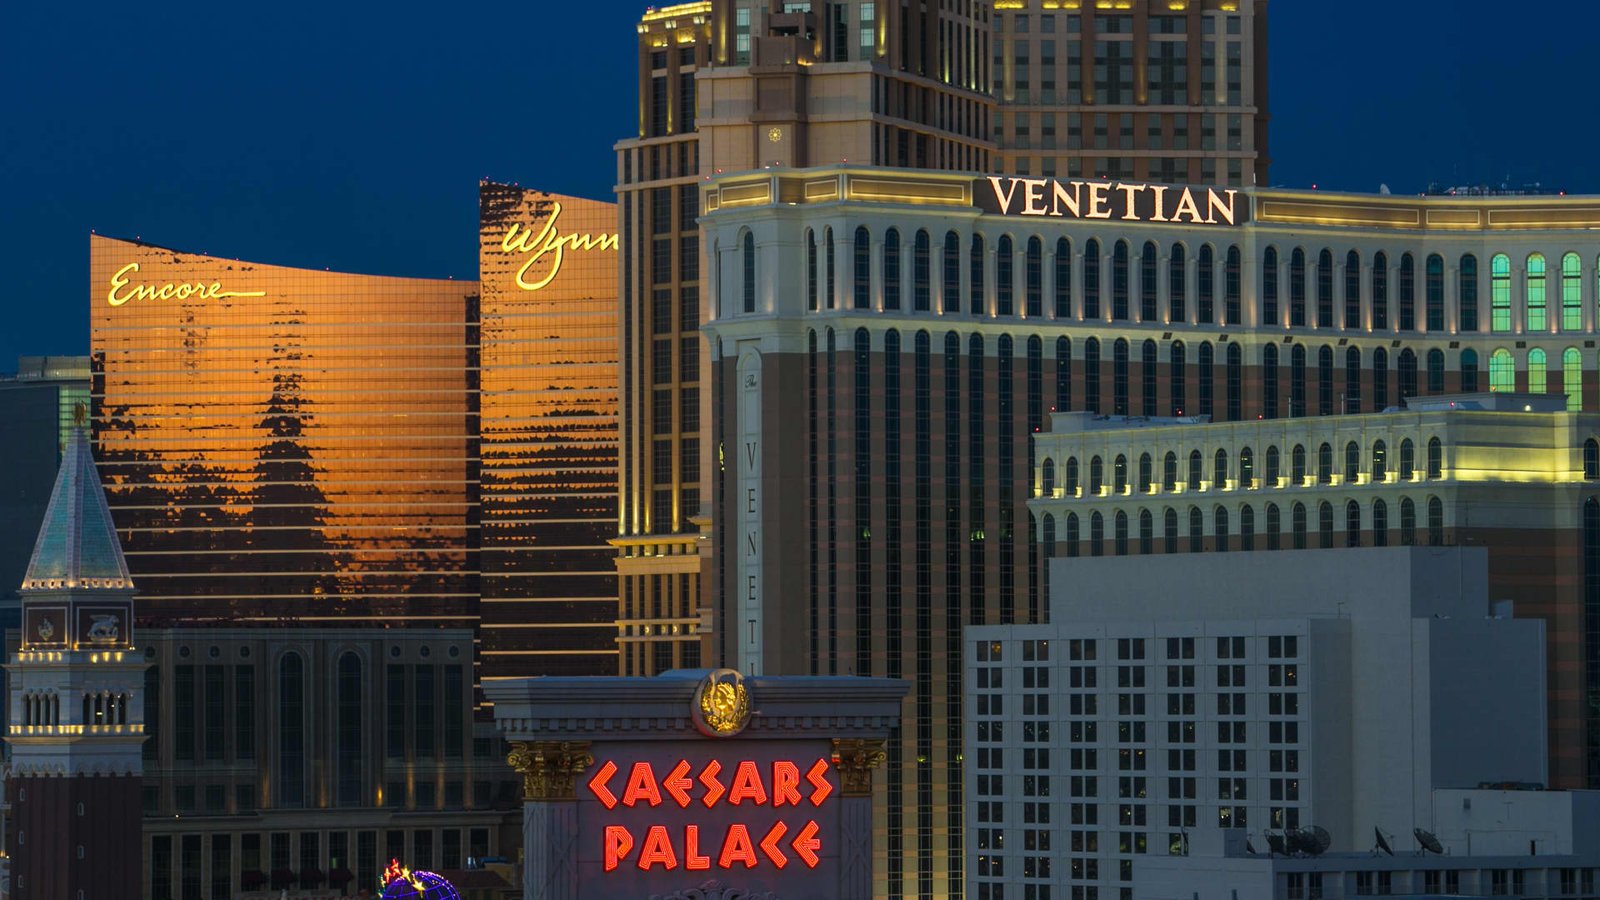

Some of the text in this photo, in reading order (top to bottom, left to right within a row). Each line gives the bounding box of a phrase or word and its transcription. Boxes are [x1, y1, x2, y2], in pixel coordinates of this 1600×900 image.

[986, 176, 1239, 226] VENETIAN
[501, 201, 619, 291] Wynn
[107, 262, 267, 308] Encore
[588, 758, 834, 809] CAESARS
[603, 819, 822, 872] PALACE
